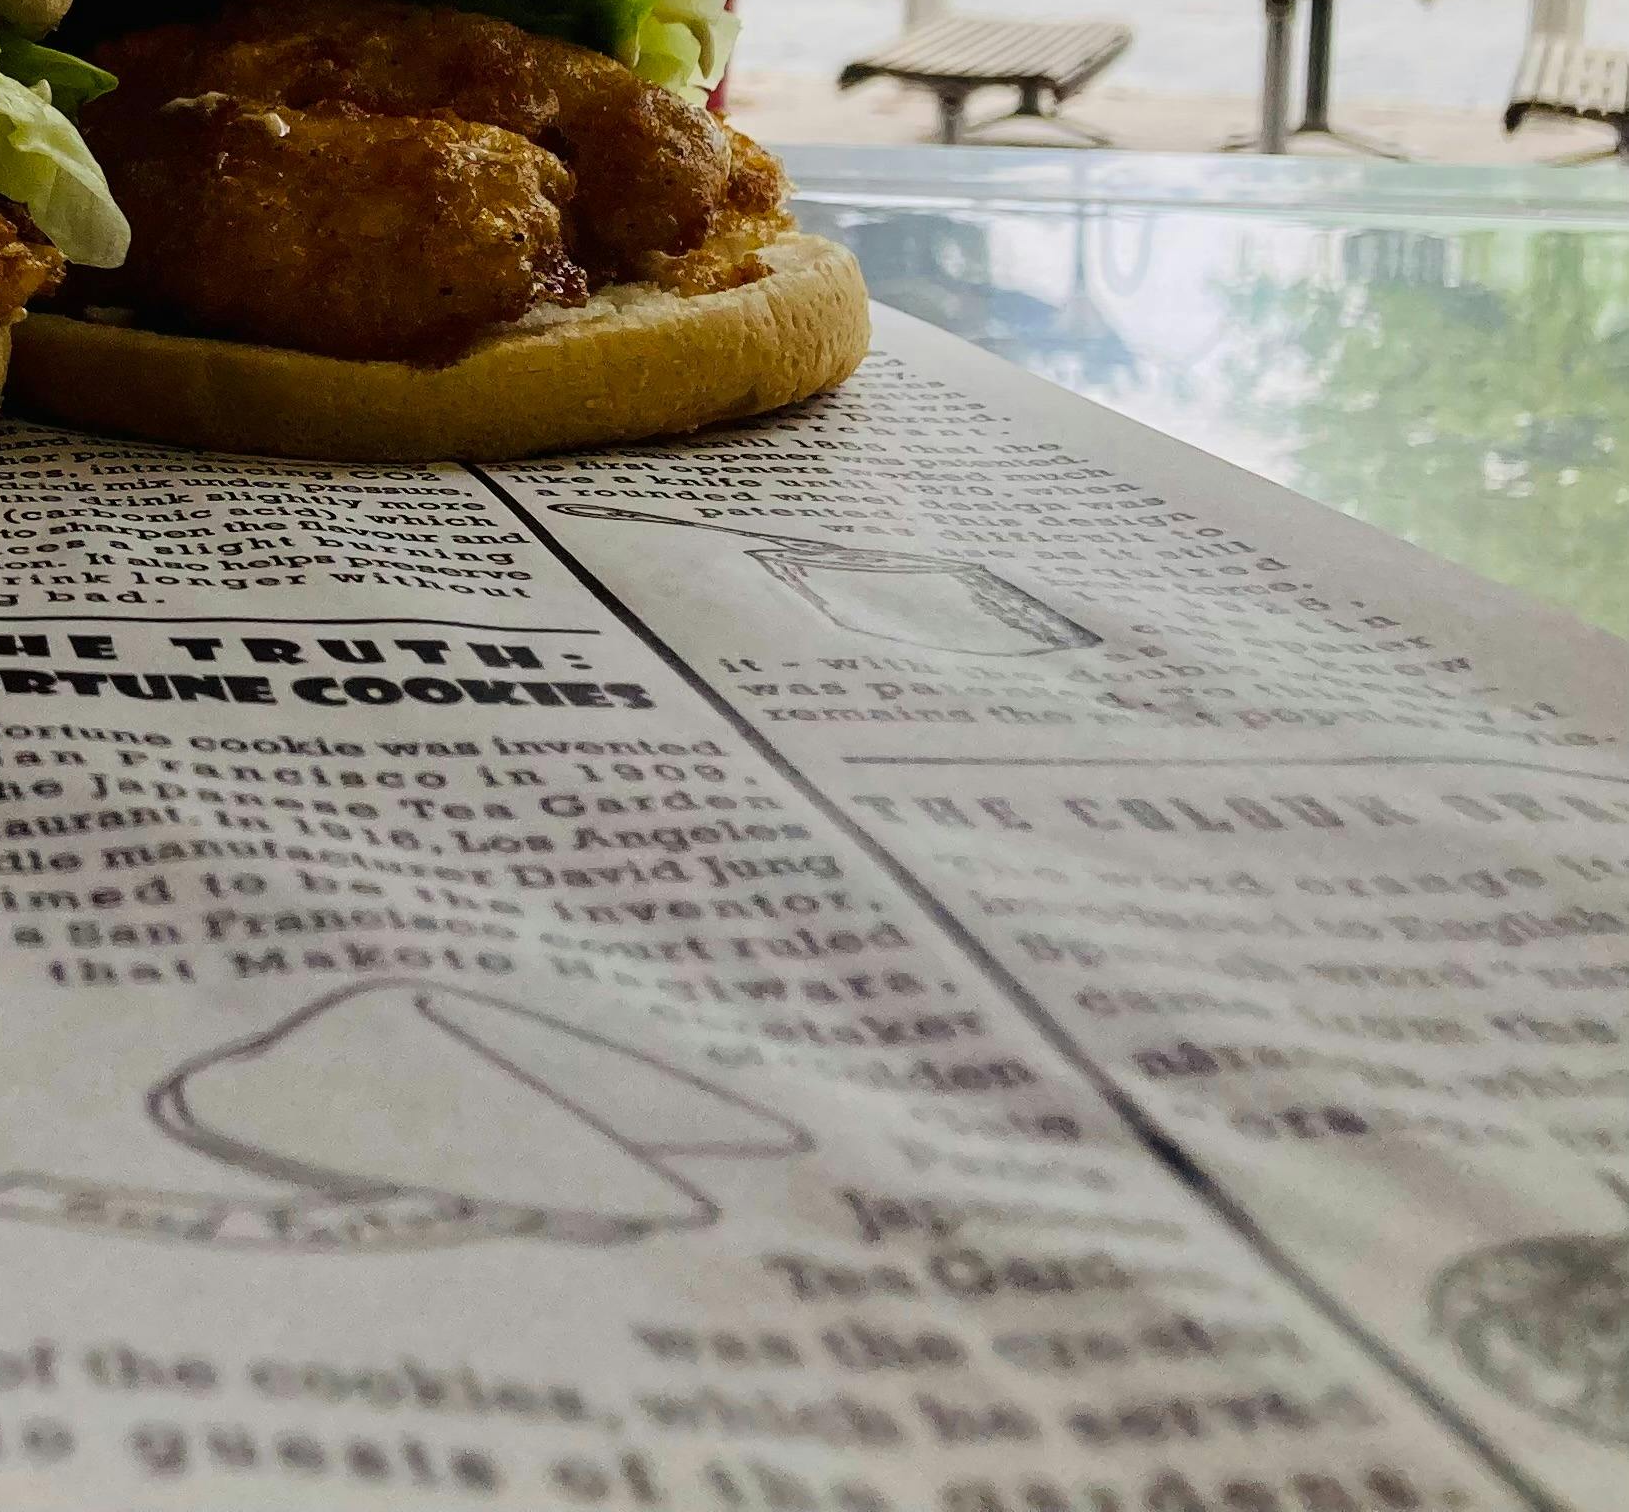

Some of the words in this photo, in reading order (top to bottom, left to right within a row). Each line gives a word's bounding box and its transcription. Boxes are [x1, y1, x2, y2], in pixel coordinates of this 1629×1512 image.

[692, 452, 826, 463] opener
[834, 455, 906, 466] was
[911, 454, 1090, 468] patented.
[900, 444, 985, 455] that
[992, 442, 1063, 454] the
[89, 462, 334, 481] introducing
[347, 469, 442, 482] CO2
[574, 461, 661, 472] first
[669, 464, 835, 476] openers
[839, 468, 995, 482] worked
[1001, 468, 1117, 482] much
[102, 477, 176, 490] mix
[178, 476, 291, 491] under
[302, 480, 474, 498] pressure,
[510, 474, 595, 485] like
[612, 474, 638, 485] a
[643, 474, 763, 488] knife
[775, 478, 879, 490] until
[1021, 482, 1142, 497] when
[77, 491, 194, 507] drink
[205, 490, 363, 510] slightly
[378, 499, 487, 512] more
[535, 488, 562, 497] a
[572, 487, 763, 502] rounded
[770, 490, 906, 507] wheel
[918, 497, 1073, 514] design
[1077, 496, 1168, 511] was
[2, 506, 213, 524] (carbonic
[228, 504, 357, 522] acid),
[363, 512, 500, 528] which
[692, 506, 915, 522] patented.
[921, 512, 1023, 528] This
[1037, 511, 1200, 528] design
[48, 521, 217, 540] sharpen
[223, 519, 289, 535] the
[297, 519, 442, 545] flavour
[451, 531, 533, 546] and
[819, 524, 916, 537] was
[1170, 526, 1224, 540] to
[108, 539, 134, 552] a
[153, 534, 298, 556] slight
[312, 535, 516, 565] burning
[82, 550, 117, 566] It
[125, 556, 212, 573] also
[220, 553, 338, 573] helps
[342, 555, 534, 582] preserve
[41, 589, 167, 605] bad.
[129, 570, 310, 592] longer
[326, 570, 534, 600] without
[167, 637, 595, 672] TRUTH:
[290, 674, 660, 711] COOKIES
[187, 734, 367, 759] cookie
[375, 741, 483, 758] was
[489, 734, 731, 759] invented
[115, 748, 449, 790] Francisco
[476, 763, 547, 789] in
[87, 771, 380, 820] Japanese
[397, 796, 518, 821] Tea
[537, 790, 784, 819] Garden
[849, 793, 1035, 834] THE
[446, 826, 558, 855] Los
[569, 815, 812, 854] Angeles
[198, 869, 269, 900] to
[506, 857, 693, 890] David
[696, 854, 846, 890] Jung
